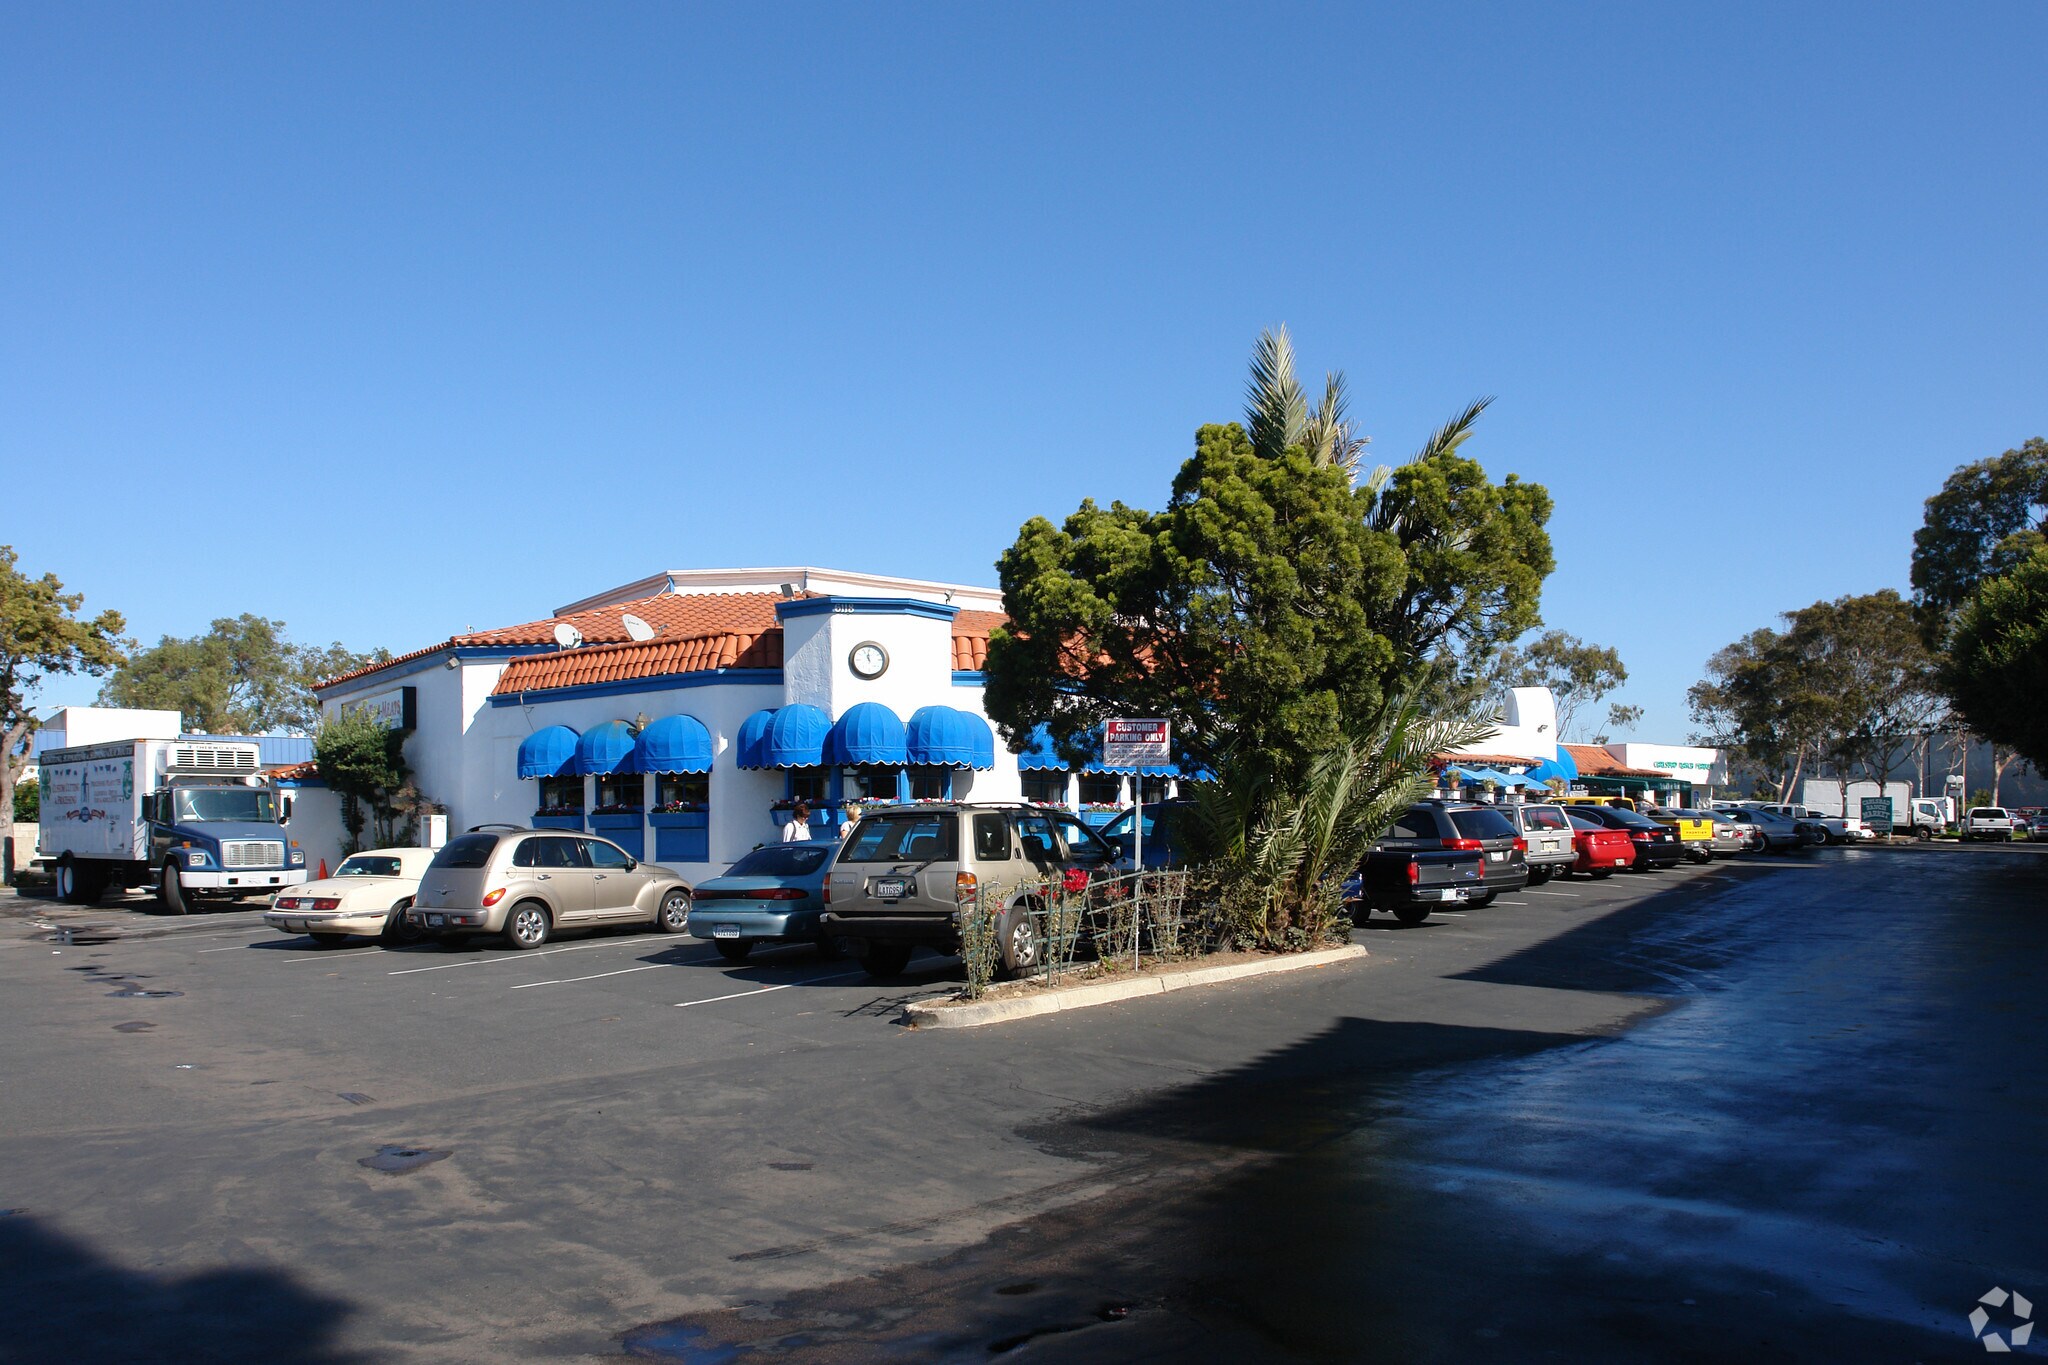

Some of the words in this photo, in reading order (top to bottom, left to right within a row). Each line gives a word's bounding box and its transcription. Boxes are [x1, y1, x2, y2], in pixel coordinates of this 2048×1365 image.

[834, 603, 855, 613] 6118
[1116, 723, 1157, 732] CUSTOMER
[1110, 733, 1142, 742] PARKING
[1145, 733, 1164, 742] ONLY
[1862, 810, 1890, 819] MARKET
